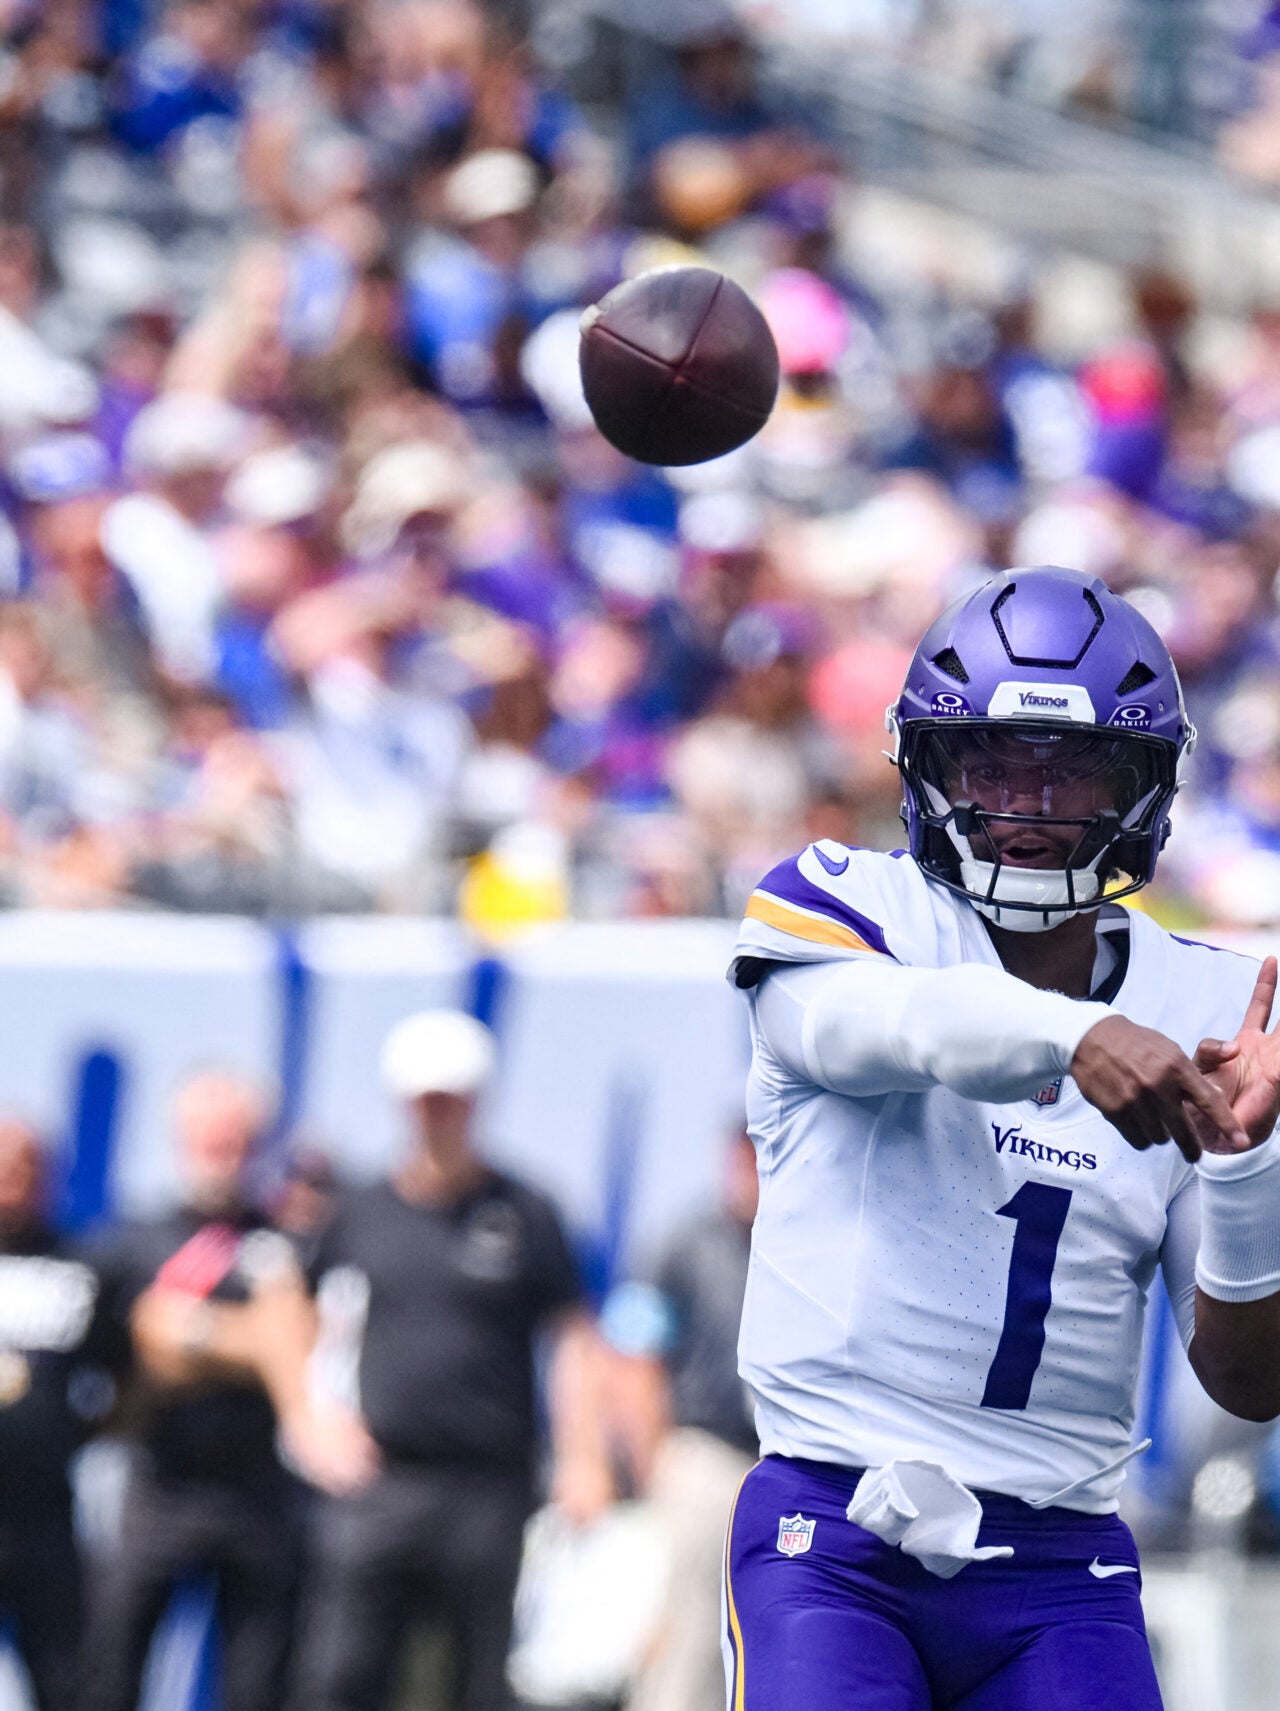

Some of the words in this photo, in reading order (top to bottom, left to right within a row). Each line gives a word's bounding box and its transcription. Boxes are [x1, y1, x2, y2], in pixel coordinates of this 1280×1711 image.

[931, 703, 969, 716] OAKLEY
[980, 1181, 1073, 1410] 1
[783, 1533, 805, 1549] NFL
